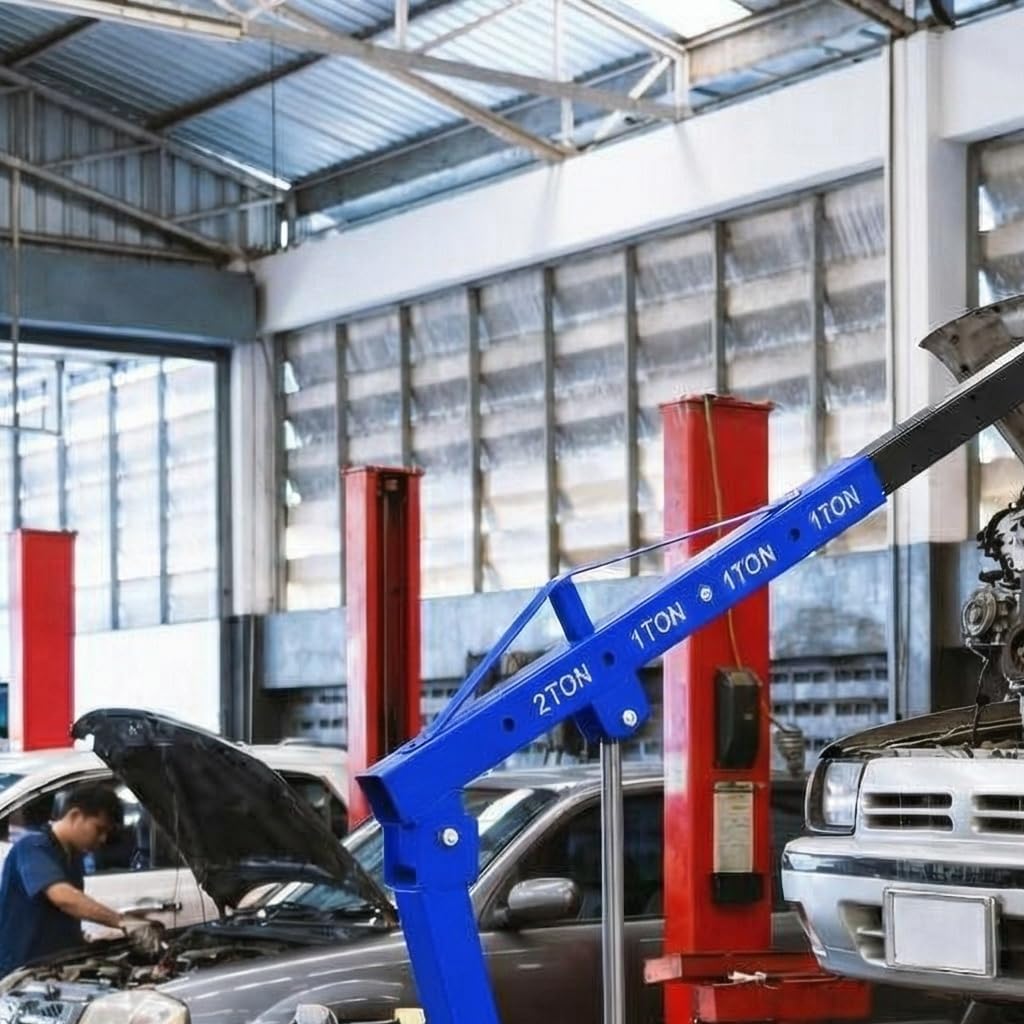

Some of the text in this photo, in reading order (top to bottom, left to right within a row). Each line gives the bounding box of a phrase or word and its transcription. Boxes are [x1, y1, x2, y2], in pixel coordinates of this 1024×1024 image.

[808, 485, 861, 531] 1TON
[723, 544, 777, 591] 1TON
[631, 602, 687, 649] 1TON
[533, 664, 592, 716] 2TON
